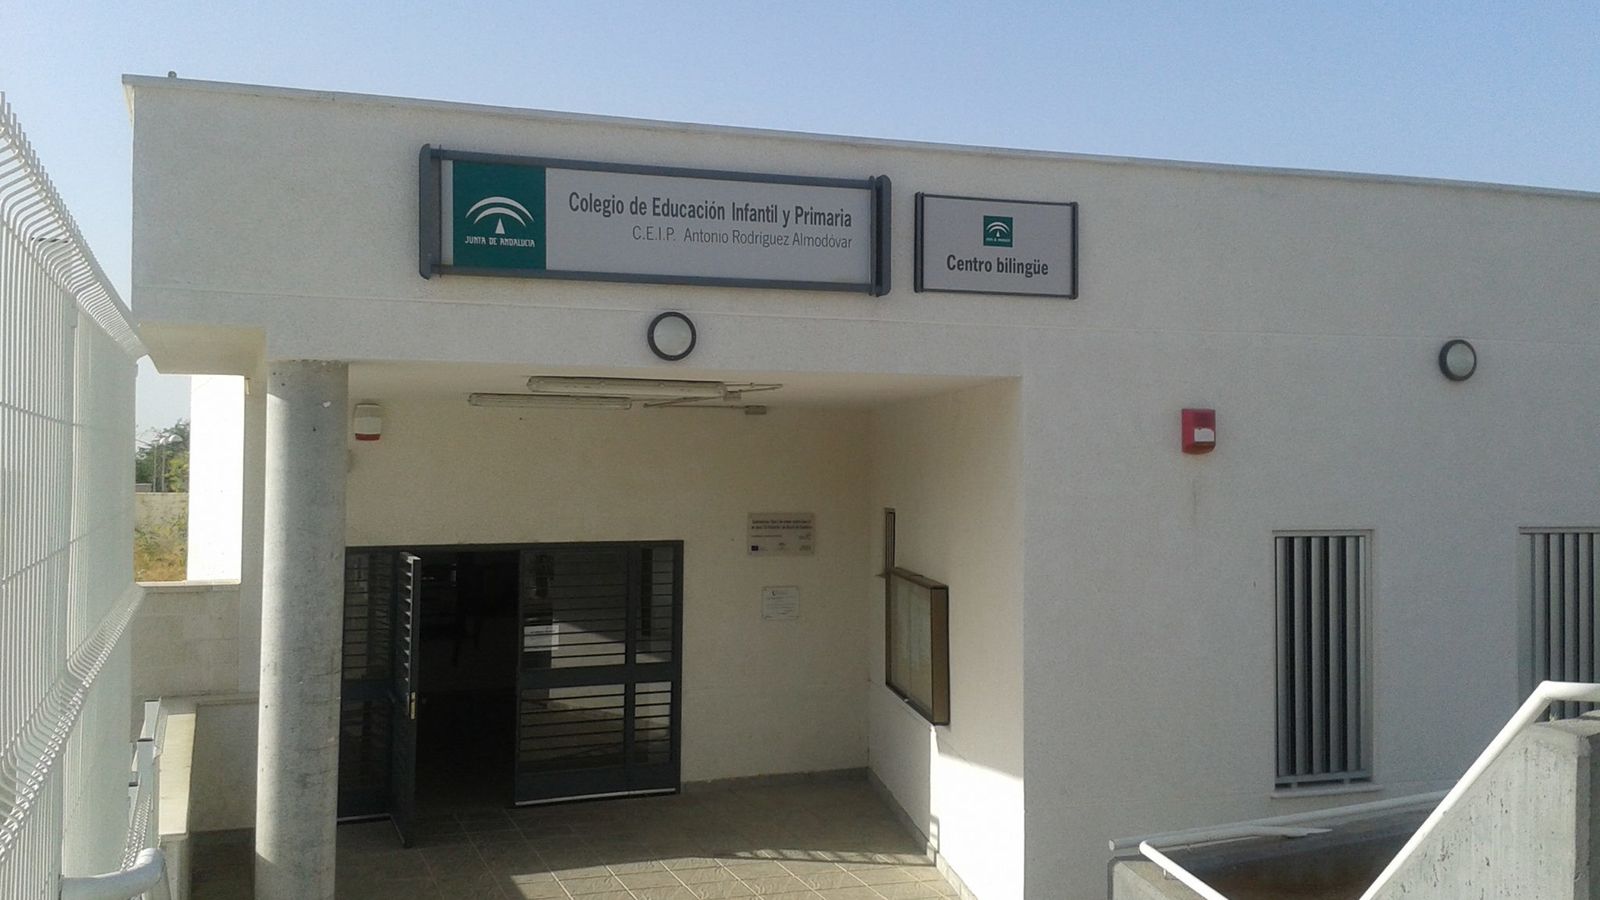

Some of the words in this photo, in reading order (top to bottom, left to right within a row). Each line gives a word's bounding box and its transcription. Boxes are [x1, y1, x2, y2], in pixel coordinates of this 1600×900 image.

[569, 191, 624, 218] Colegio
[629, 196, 647, 215] de
[652, 197, 725, 220] Educación
[732, 202, 778, 223] Infantil
[782, 209, 790, 228] y
[795, 206, 852, 227] Primaria
[465, 236, 486, 244] JUNTA
[488, 237, 497, 245] DE
[632, 225, 676, 241] C.E.I.P.
[683, 228, 729, 243] Antonio
[946, 254, 992, 272] Centro
[996, 257, 1049, 278] bilingüe
